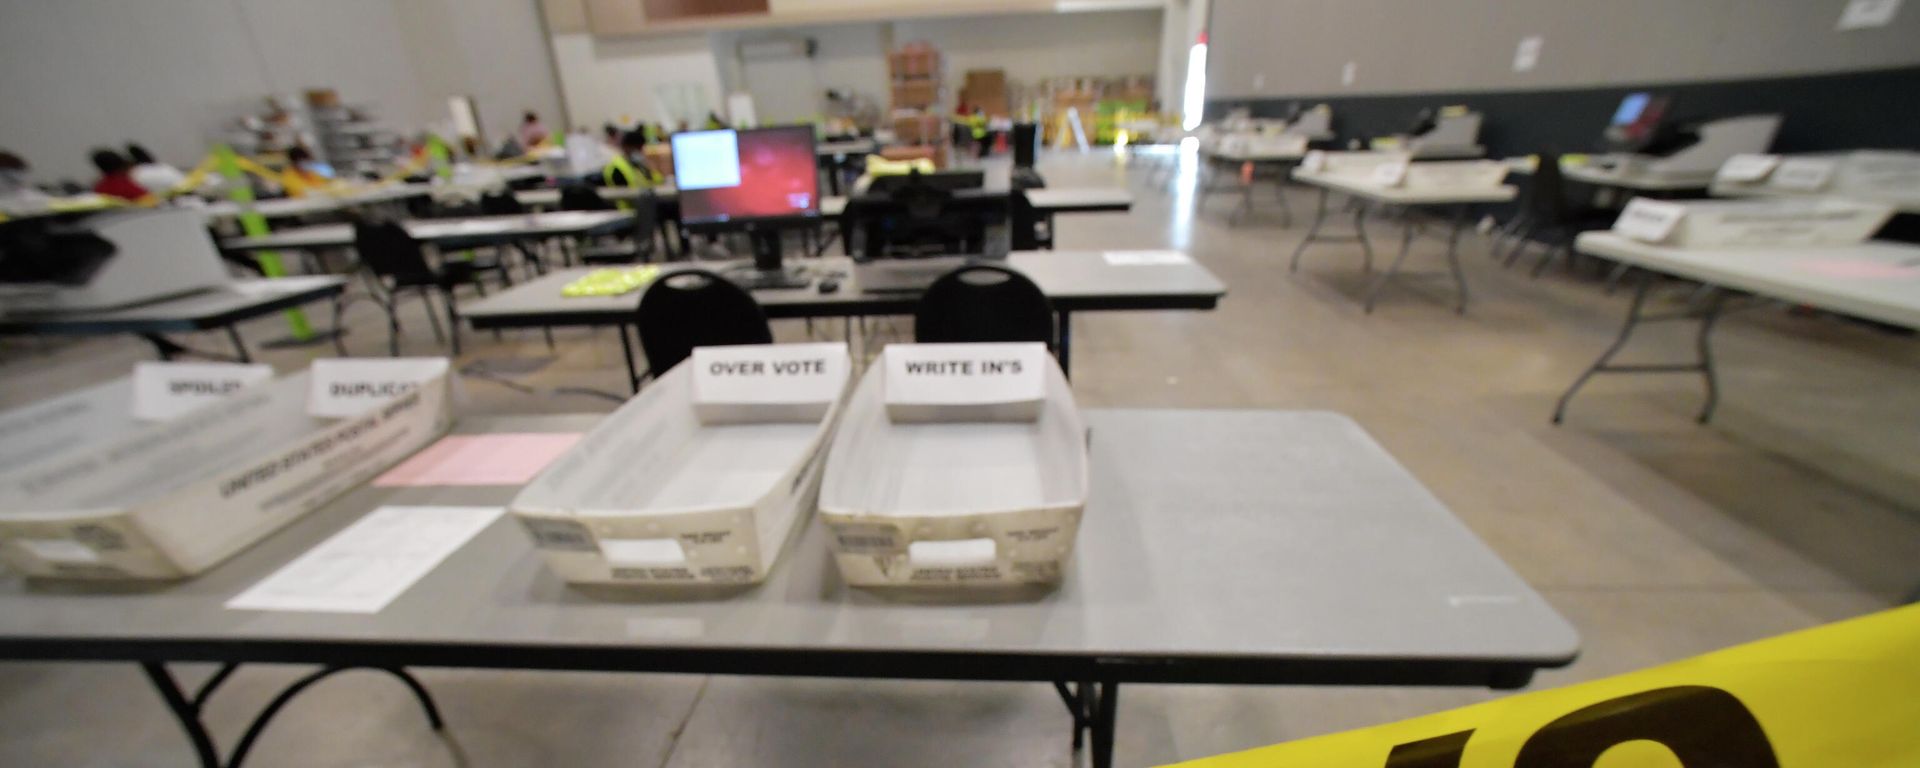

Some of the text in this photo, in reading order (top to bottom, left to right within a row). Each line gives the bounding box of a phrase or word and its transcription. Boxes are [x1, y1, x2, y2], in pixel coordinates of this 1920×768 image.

[709, 360, 826, 376] OVER VOTE
[904, 359, 1023, 376] WRITE IN'S
